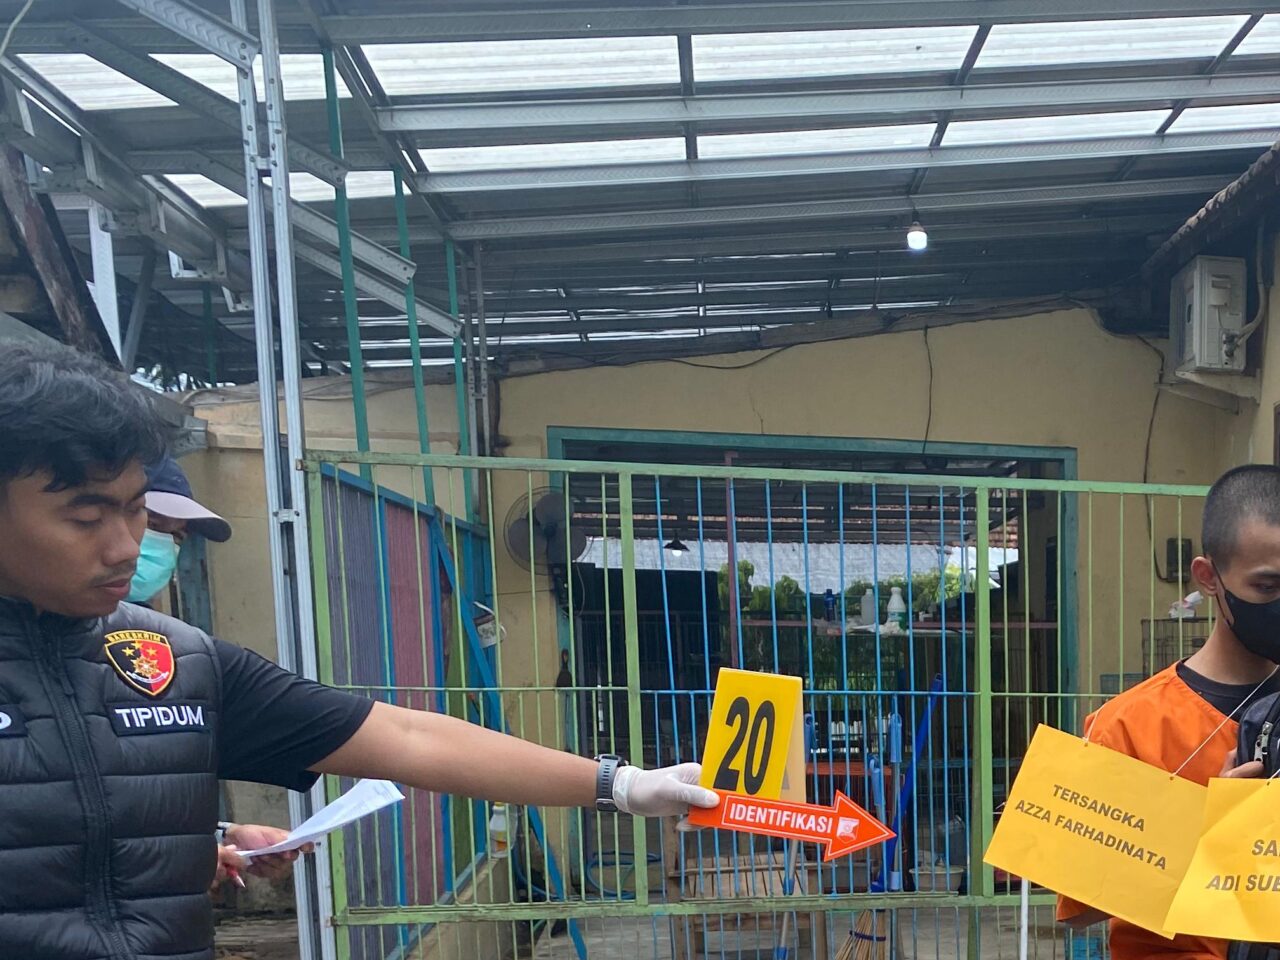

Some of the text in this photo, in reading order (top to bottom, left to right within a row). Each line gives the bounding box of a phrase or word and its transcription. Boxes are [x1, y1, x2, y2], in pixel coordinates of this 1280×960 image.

[115, 706, 204, 727] TIPIDUM
[713, 696, 775, 795] 20
[730, 804, 833, 833] IDENTIFIKASI
[1053, 784, 1145, 831] TERSANGKA
[1015, 799, 1167, 870] AZZA FARHADINATA
[1206, 875, 1240, 891] ADI
